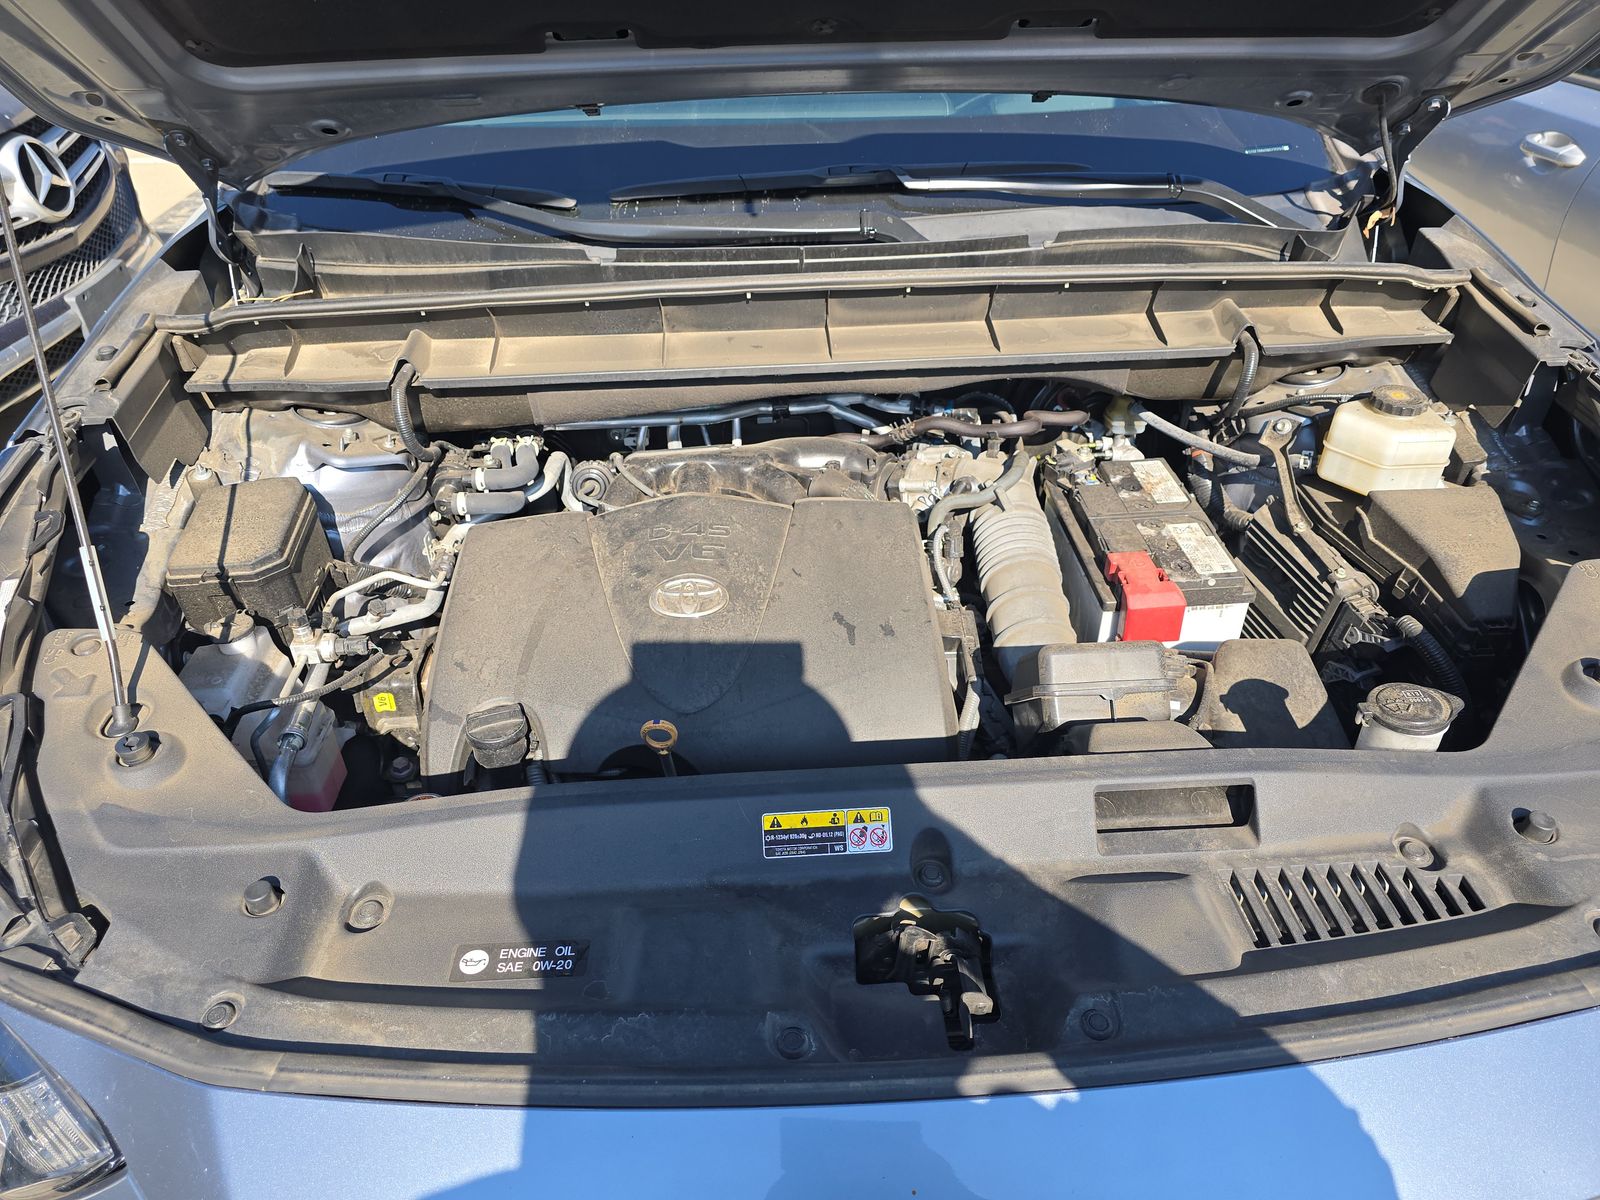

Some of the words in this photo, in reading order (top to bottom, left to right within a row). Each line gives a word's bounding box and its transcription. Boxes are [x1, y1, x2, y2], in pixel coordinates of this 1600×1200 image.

[499, 947, 547, 959] ENGINE
[555, 946, 575, 957] OIL
[496, 961, 524, 973] SAE
[532, 959, 573, 972] 0W-20
